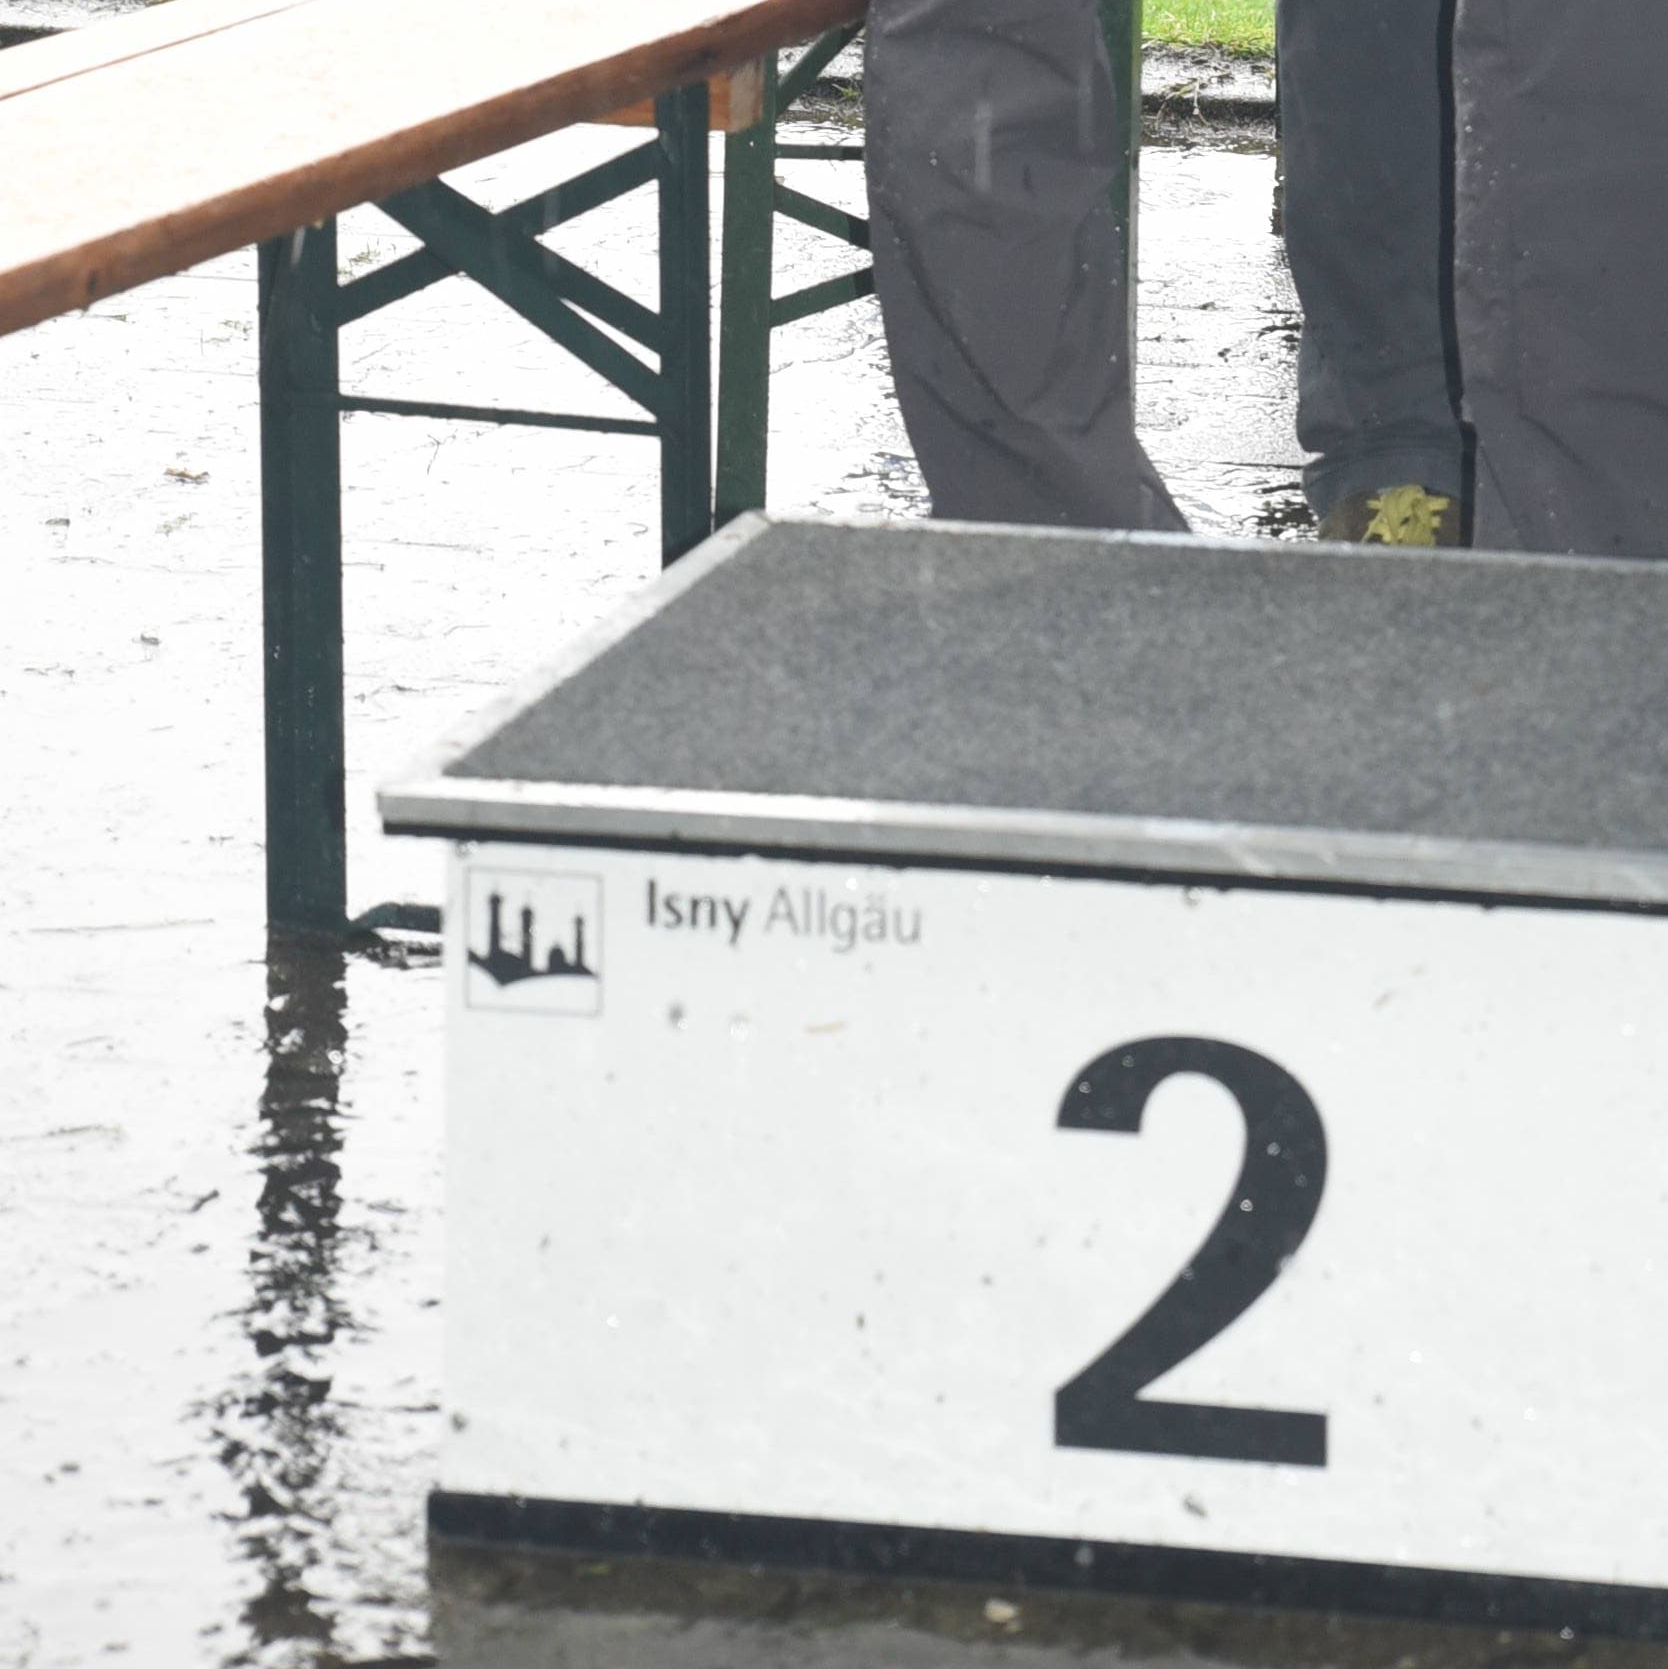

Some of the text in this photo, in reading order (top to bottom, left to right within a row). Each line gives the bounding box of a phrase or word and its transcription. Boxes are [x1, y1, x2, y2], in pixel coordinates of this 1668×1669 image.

[647, 878, 923, 952] Isny Allgäu
[1054, 1034, 1328, 1468] 2
